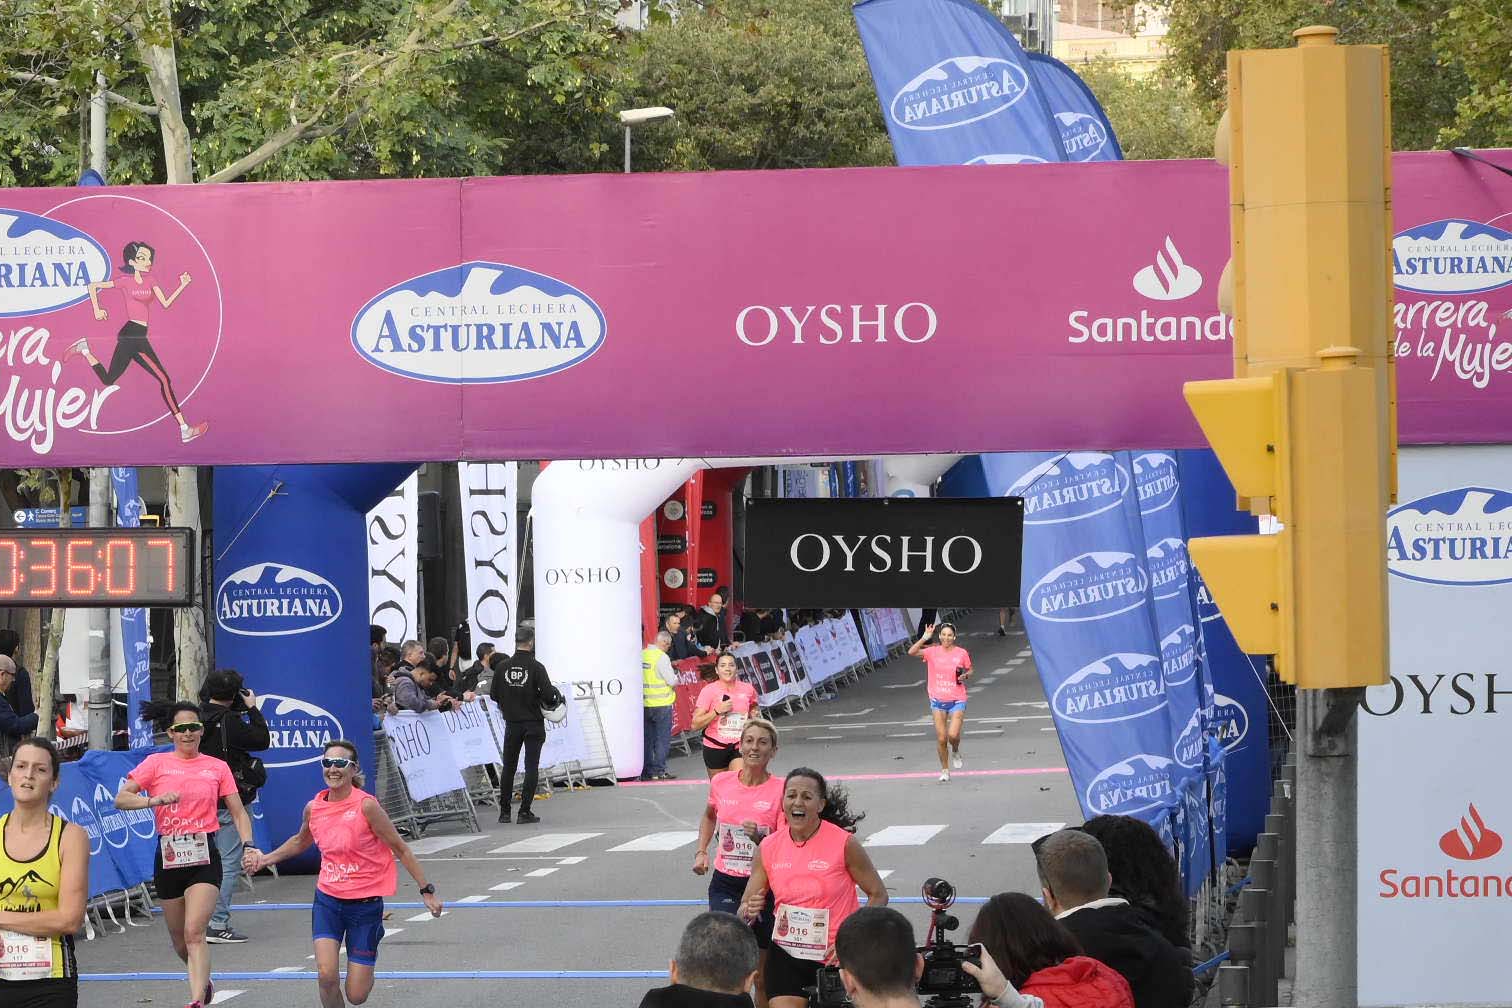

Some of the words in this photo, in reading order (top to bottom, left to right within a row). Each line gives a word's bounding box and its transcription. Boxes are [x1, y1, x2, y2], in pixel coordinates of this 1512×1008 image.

[14, 244, 87, 257] LECHERA
[409, 304, 489, 317] CENTRAL
[497, 302, 578, 315] LECHERA
[1393, 299, 1489, 329] arrera
[370, 309, 587, 354] ASTURIANA
[734, 301, 939, 347] OYSHO
[1417, 328, 1435, 358] la
[1430, 323, 1512, 389] Muje
[1414, 521, 1482, 532] CENTRAL
[789, 533, 983, 574] OYSHO
[545, 566, 621, 586] OYSHO
[279, 586, 329, 596] LECHERA
[220, 592, 334, 620] ASTURIANA
[510, 671, 523, 681] BP
[269, 730, 332, 749] RIANA
[735, 842, 752, 850] 016
[789, 926, 808, 936] 016
[7, 944, 29, 953] 016
